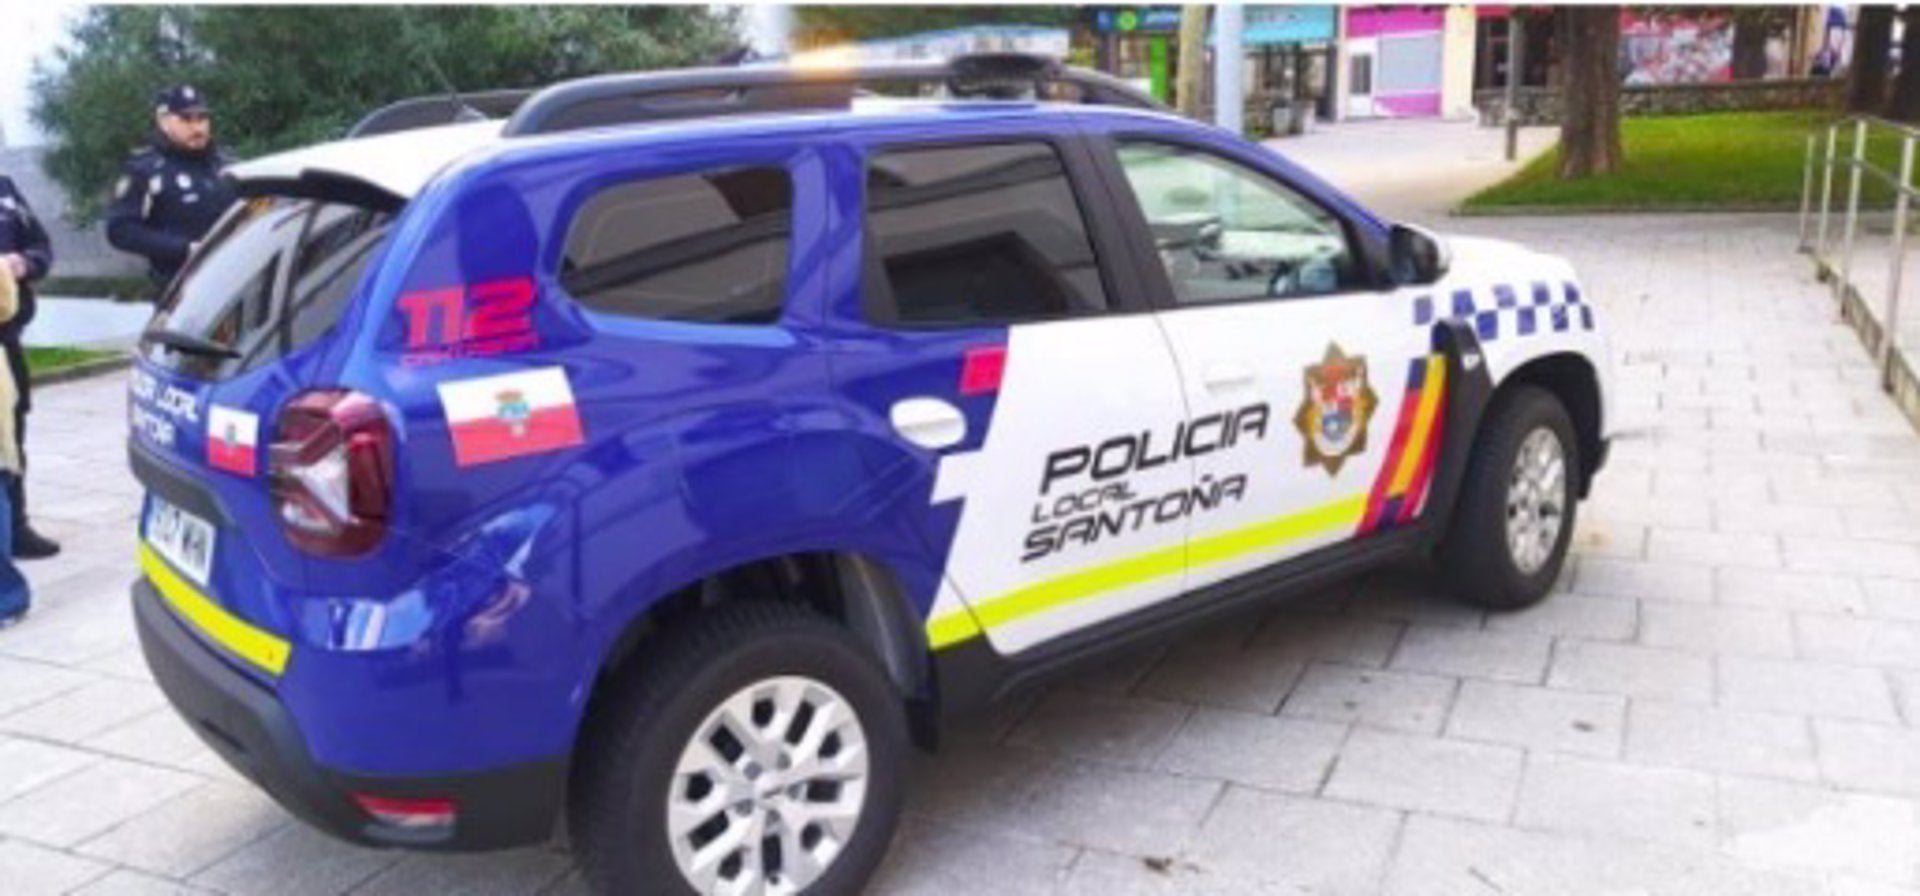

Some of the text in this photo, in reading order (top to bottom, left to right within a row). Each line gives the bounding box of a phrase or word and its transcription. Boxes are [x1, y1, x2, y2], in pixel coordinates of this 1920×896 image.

[398, 278, 536, 347] 112
[1039, 402, 1269, 496] POLICIA
[1020, 474, 1247, 564] SANTOÑA
[1031, 482, 1137, 524] LOCAL
